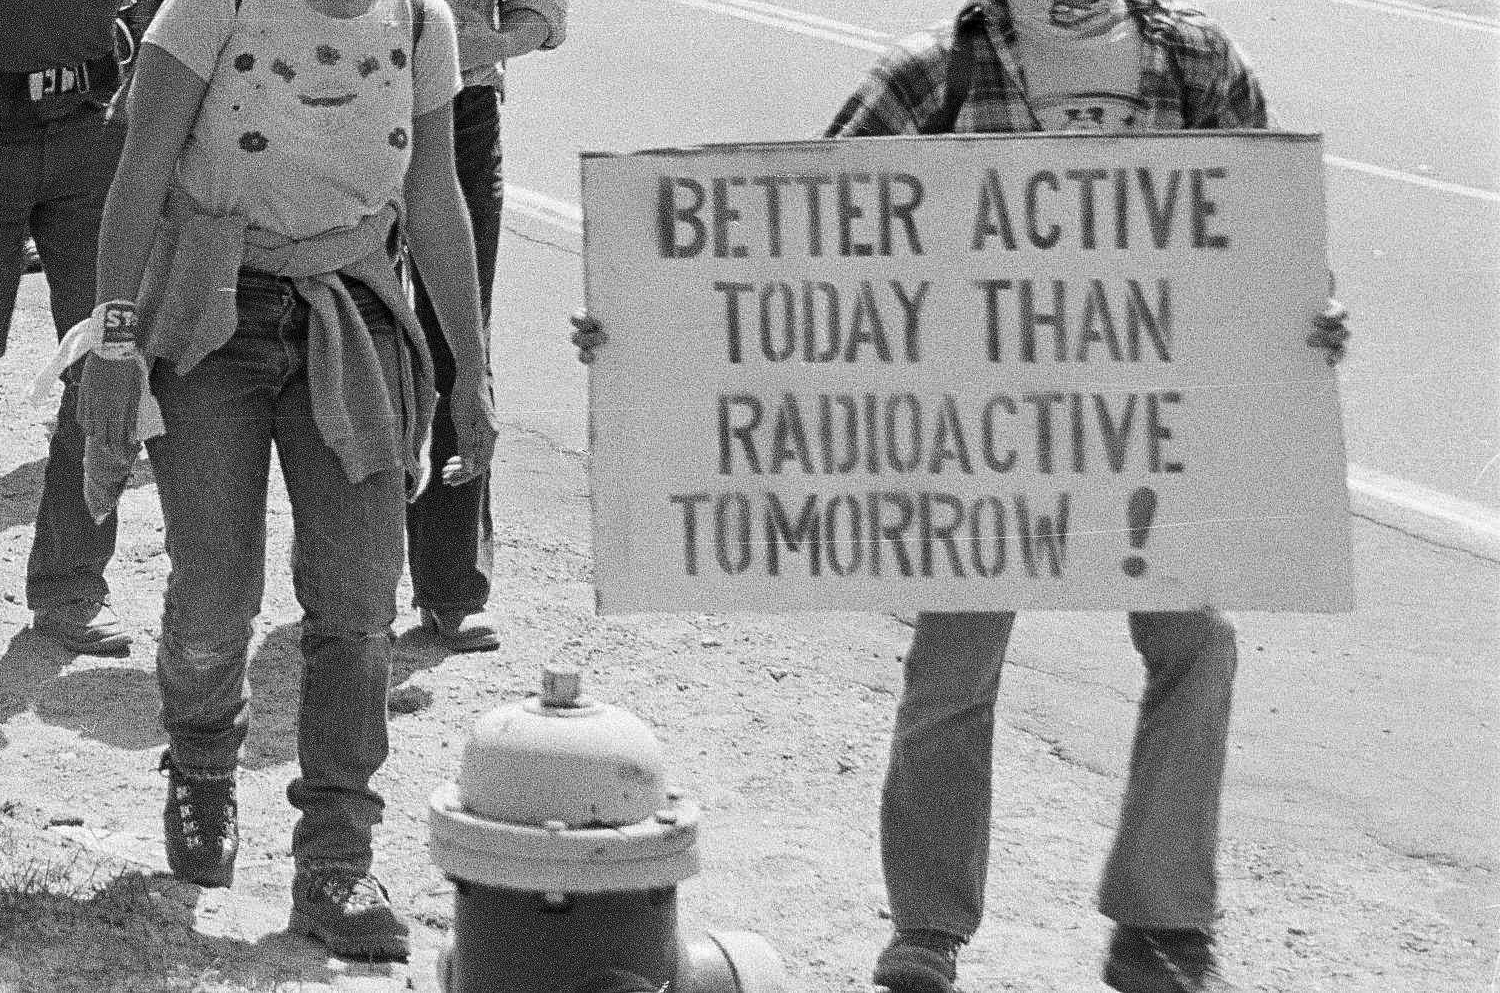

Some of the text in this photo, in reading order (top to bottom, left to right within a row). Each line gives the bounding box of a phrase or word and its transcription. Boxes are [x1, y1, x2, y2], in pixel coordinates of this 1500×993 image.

[656, 167, 1231, 259] BETTER ACTIVE
[713, 277, 1174, 364] TODAY THAN
[717, 390, 1186, 476] RADIOACTIVE
[670, 490, 1071, 578] TOMORROW
